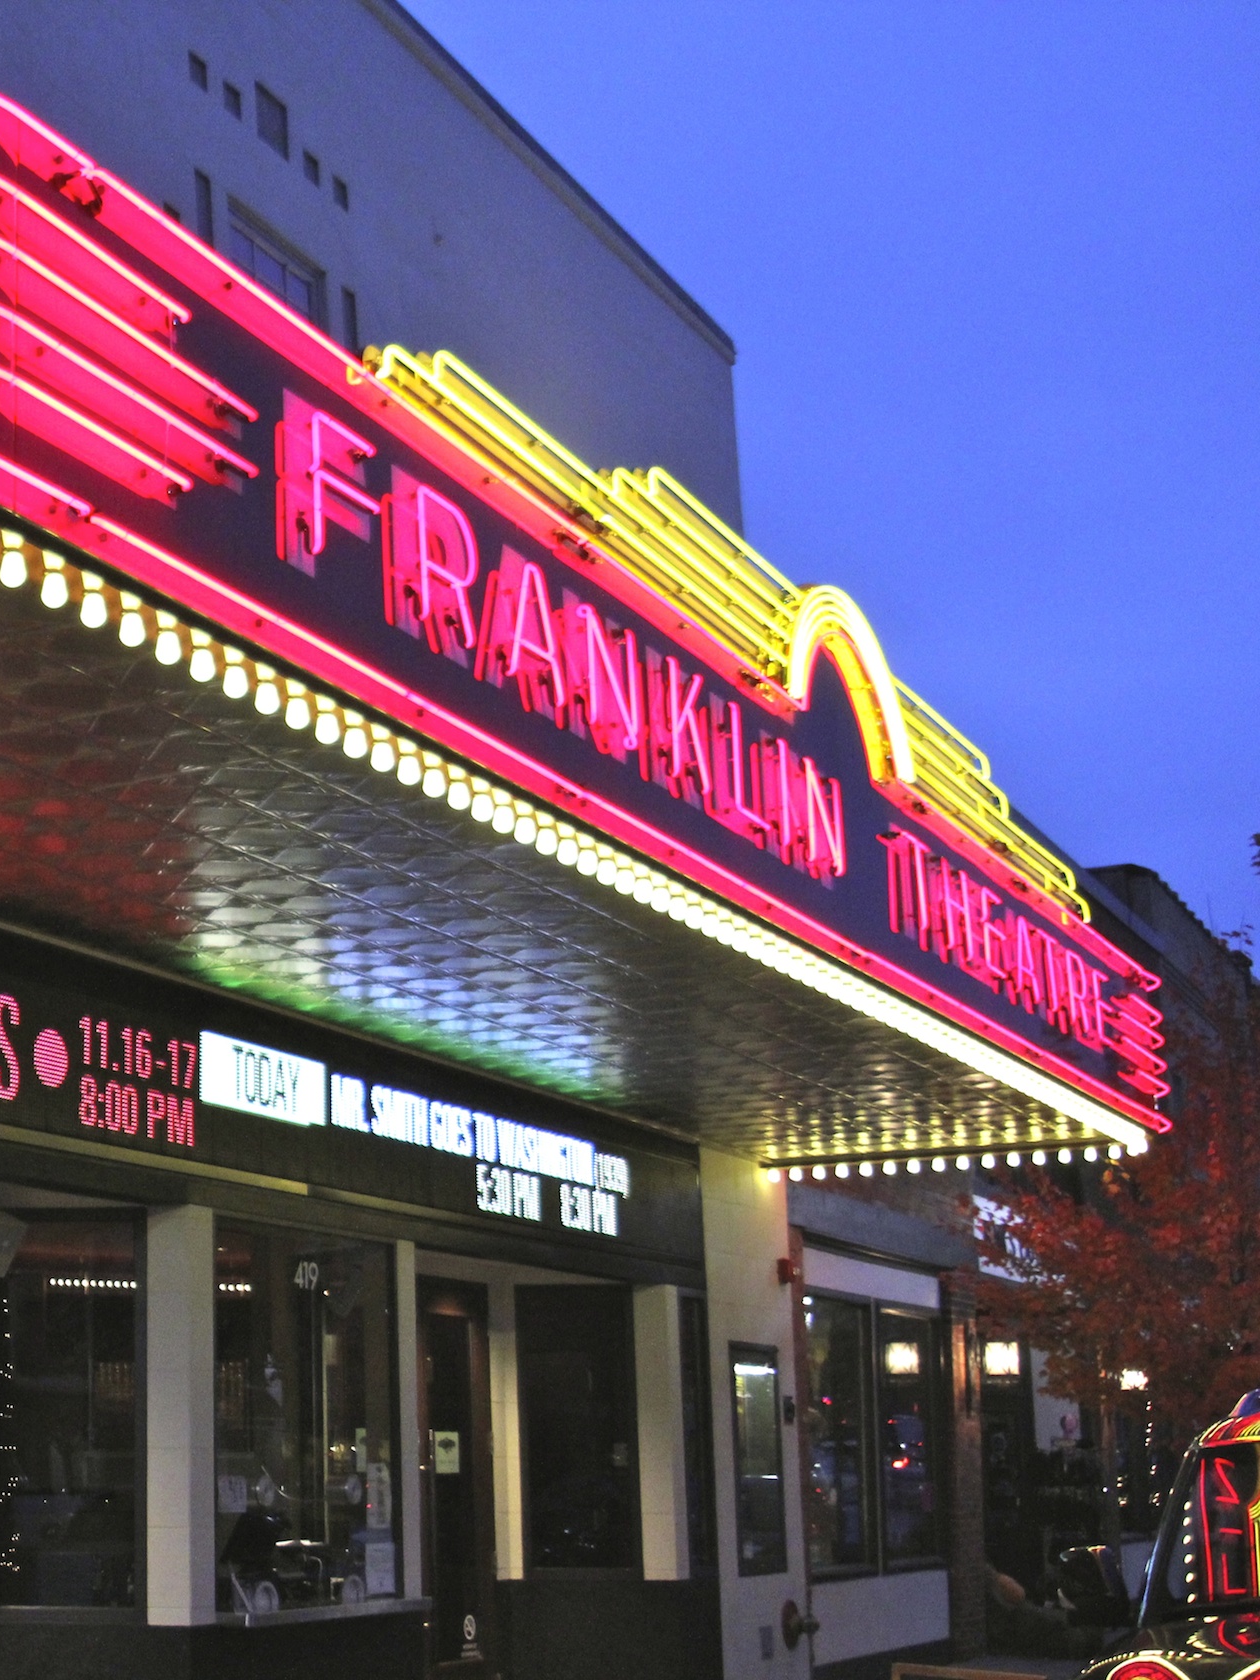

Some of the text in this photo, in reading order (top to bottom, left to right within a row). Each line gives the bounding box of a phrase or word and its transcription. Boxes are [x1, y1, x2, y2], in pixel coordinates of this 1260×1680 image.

[277, 388, 845, 885] FRANKLIN
[876, 824, 1112, 1053] THEATRE
[78, 1014, 196, 1090] 11.16-17
[231, 1044, 301, 1115] TODAY
[78, 1074, 195, 1147] 8:00 PM
[371, 1085, 429, 1147] SMITH
[430, 1101, 474, 1157] GOES
[473, 1112, 498, 1162] TO
[476, 1163, 541, 1222] 5:30 PM
[592, 1190, 618, 1237] PM
[293, 1260, 320, 1291] 419
